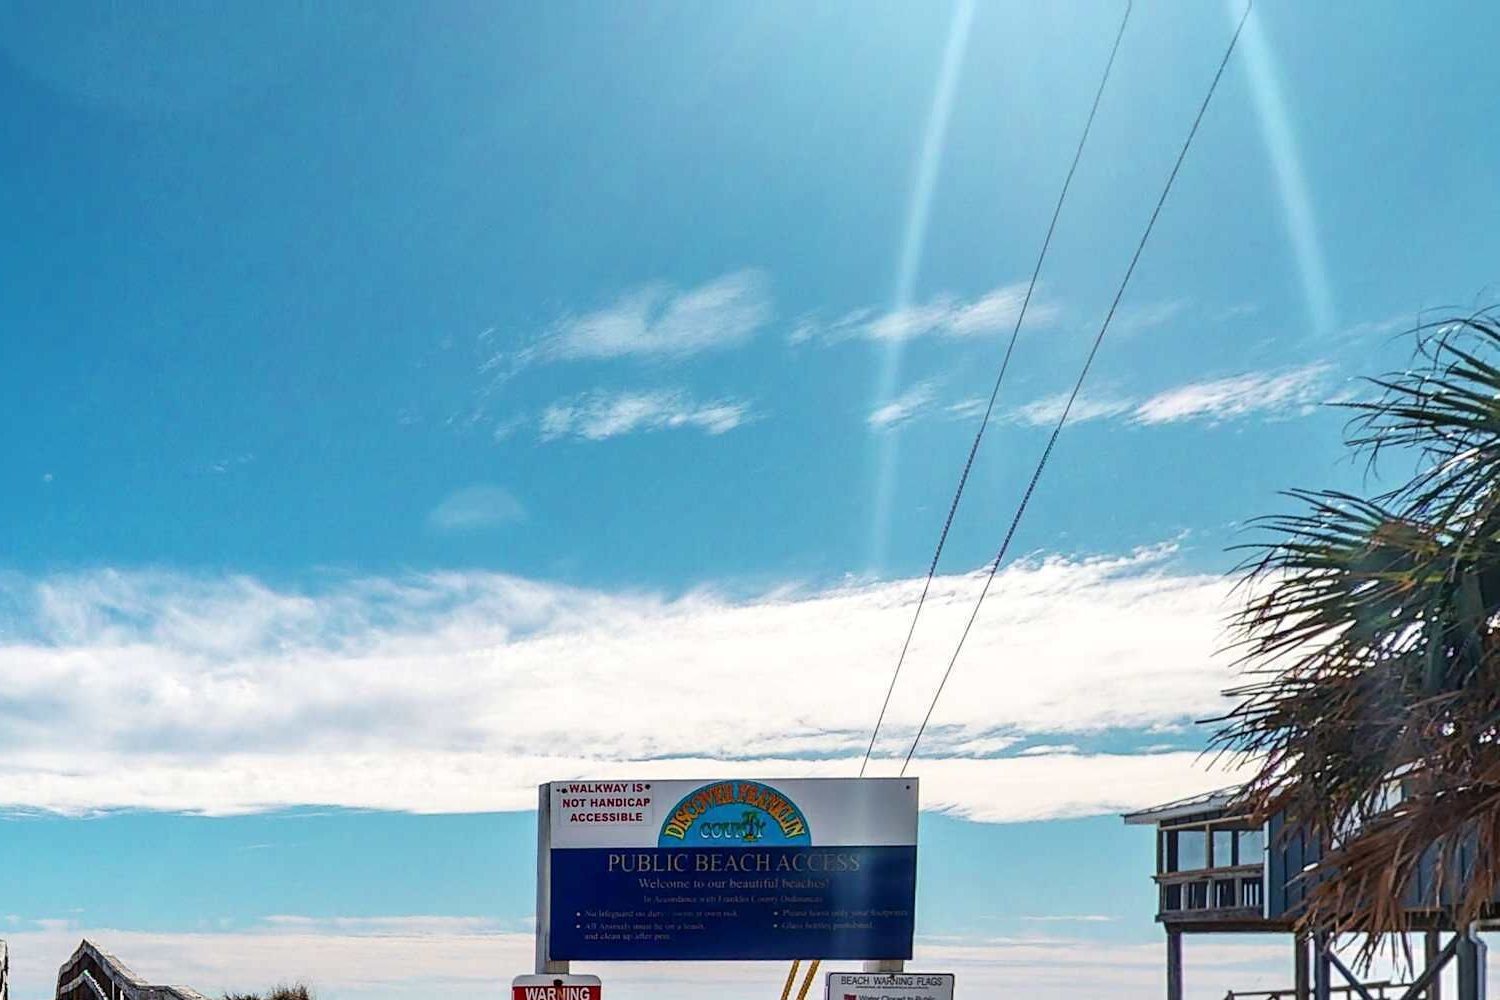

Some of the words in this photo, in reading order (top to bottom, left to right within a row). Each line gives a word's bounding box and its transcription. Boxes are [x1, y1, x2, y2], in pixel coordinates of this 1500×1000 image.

[569, 784, 628, 793] WALKWAY
[632, 783, 644, 793] IS
[562, 798, 586, 808] NOT
[590, 798, 651, 808] HANDICAP
[664, 783, 734, 840] DISCOVER
[737, 783, 806, 839] FRANKLIN
[570, 813, 643, 822] ACCESSIBLE
[608, 853, 688, 872] PUBLIC
[695, 853, 771, 872] BEACH
[776, 853, 861, 872] ACCESS
[638, 878, 690, 889] Welcome
[693, 880, 704, 889] to
[707, 880, 726, 889] our
[729, 878, 778, 889] beautiful
[782, 878, 830, 889] beaches!
[841, 976, 870, 986] BEACH
[873, 976, 914, 986] WARNING
[916, 976, 943, 986] FLAGS
